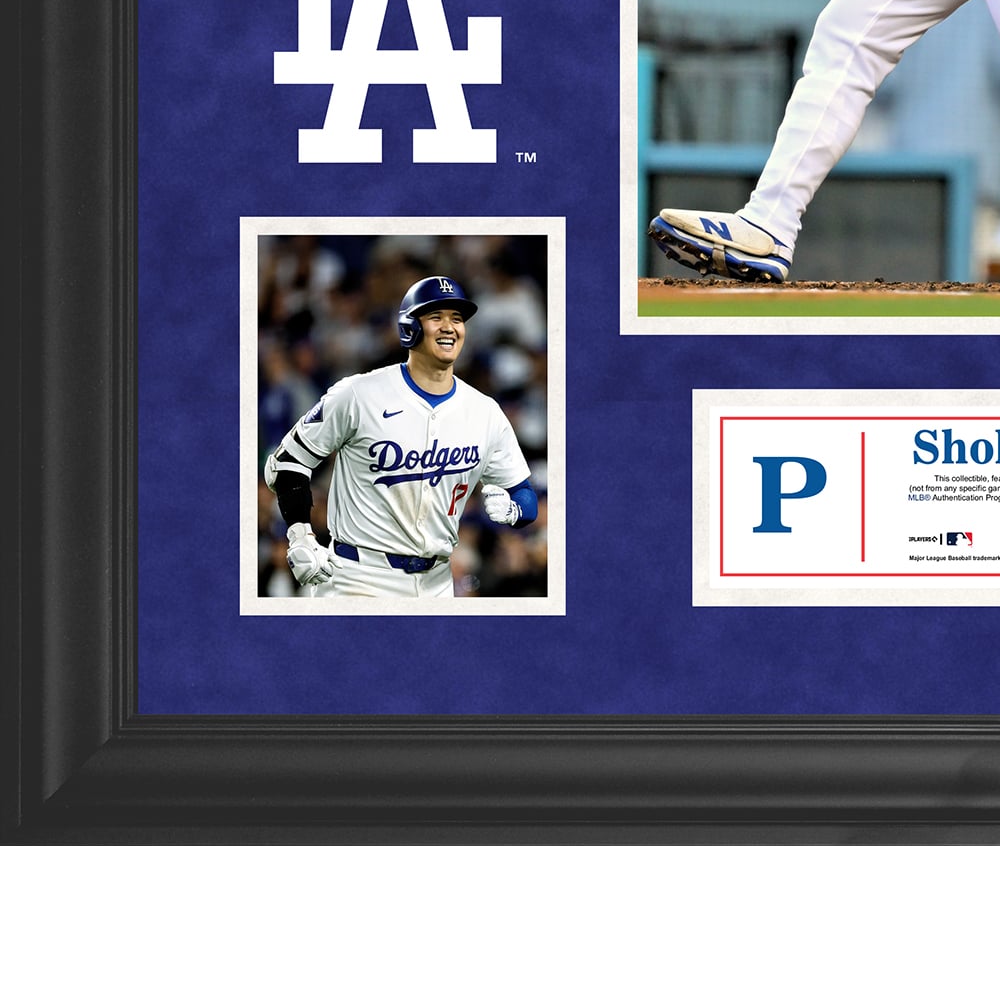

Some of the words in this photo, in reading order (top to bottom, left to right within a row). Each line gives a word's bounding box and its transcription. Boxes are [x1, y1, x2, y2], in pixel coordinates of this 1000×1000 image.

[368, 439, 481, 488] Dodgers
[909, 485, 924, 493] (not
[959, 485, 986, 493] specific
[952, 475, 989, 483] collectible,
[753, 456, 828, 534] P
